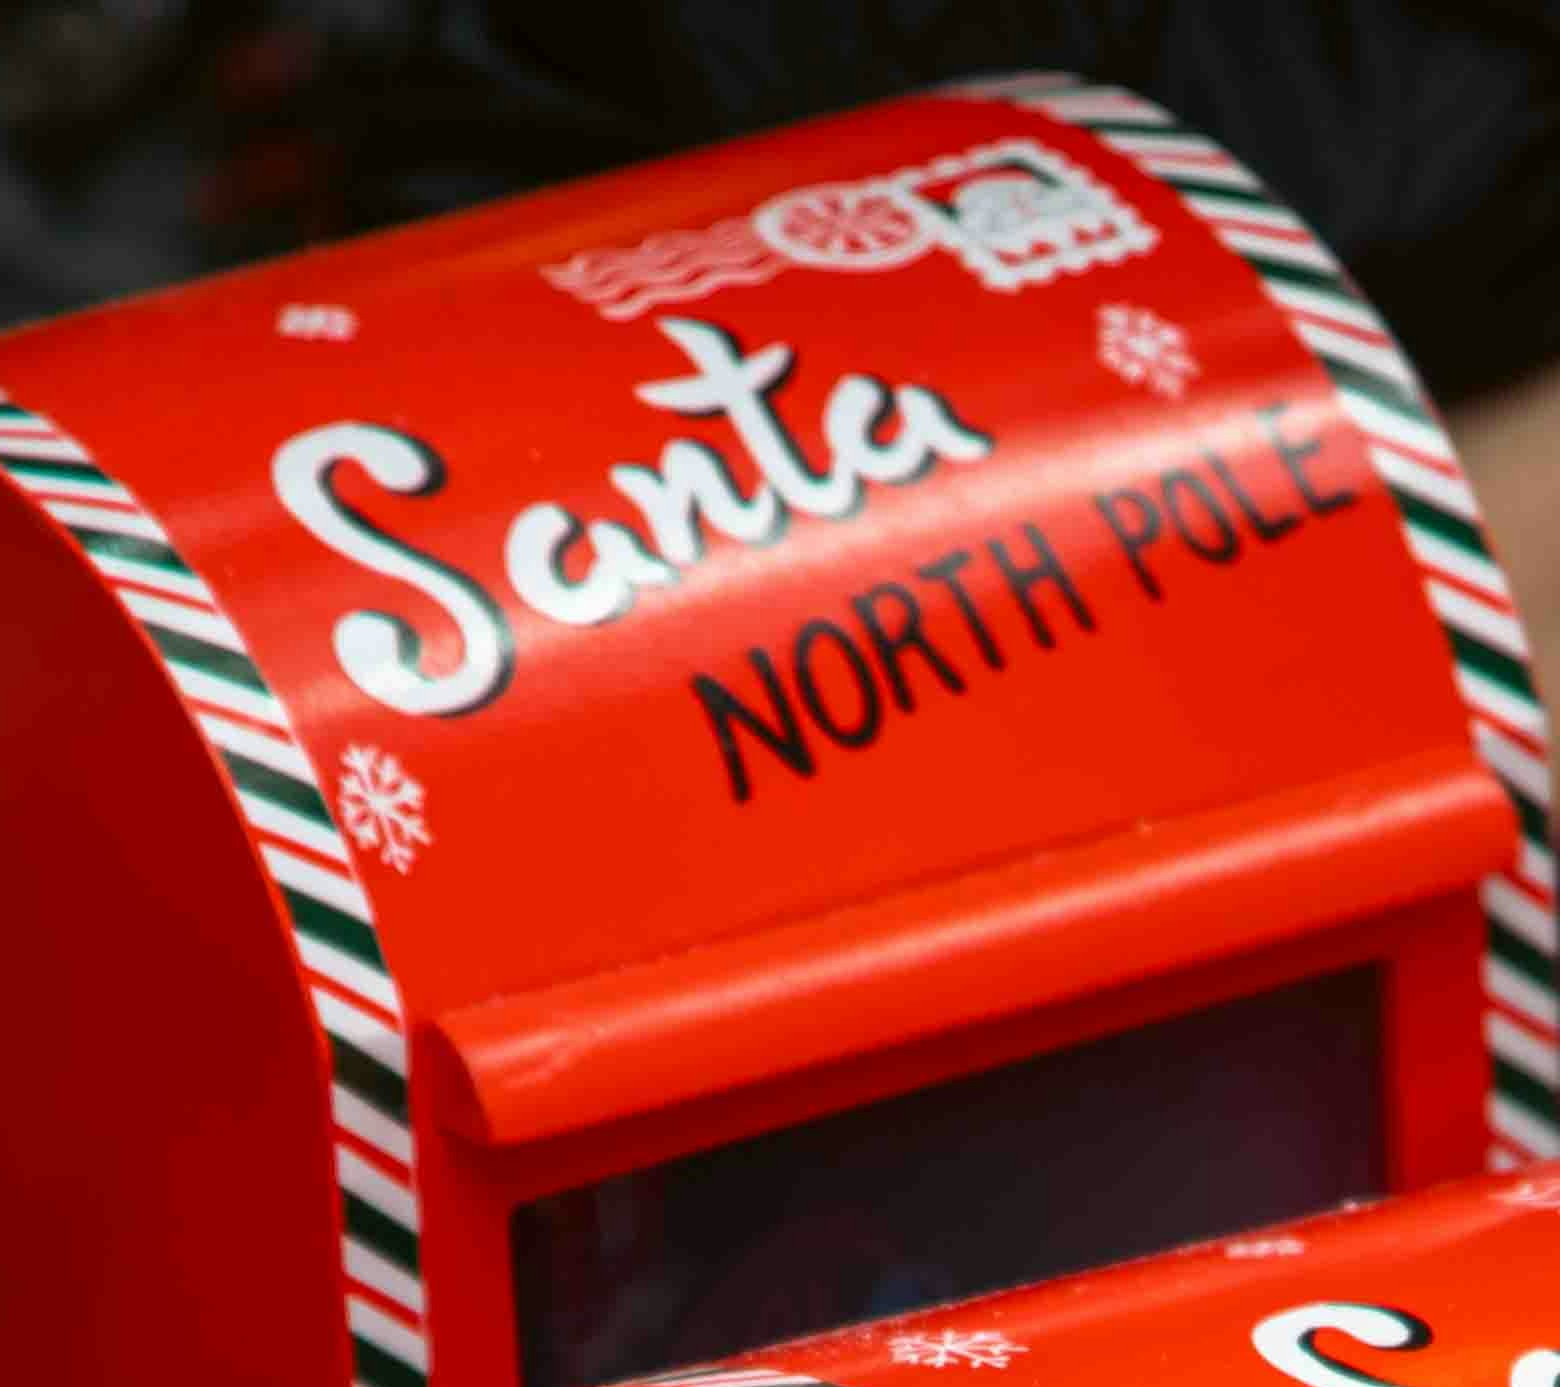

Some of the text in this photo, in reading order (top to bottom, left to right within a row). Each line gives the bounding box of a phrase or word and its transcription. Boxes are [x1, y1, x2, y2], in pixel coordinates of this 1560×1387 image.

[272, 317, 995, 717] Santa
[692, 402, 1360, 804] NORTH POLE
